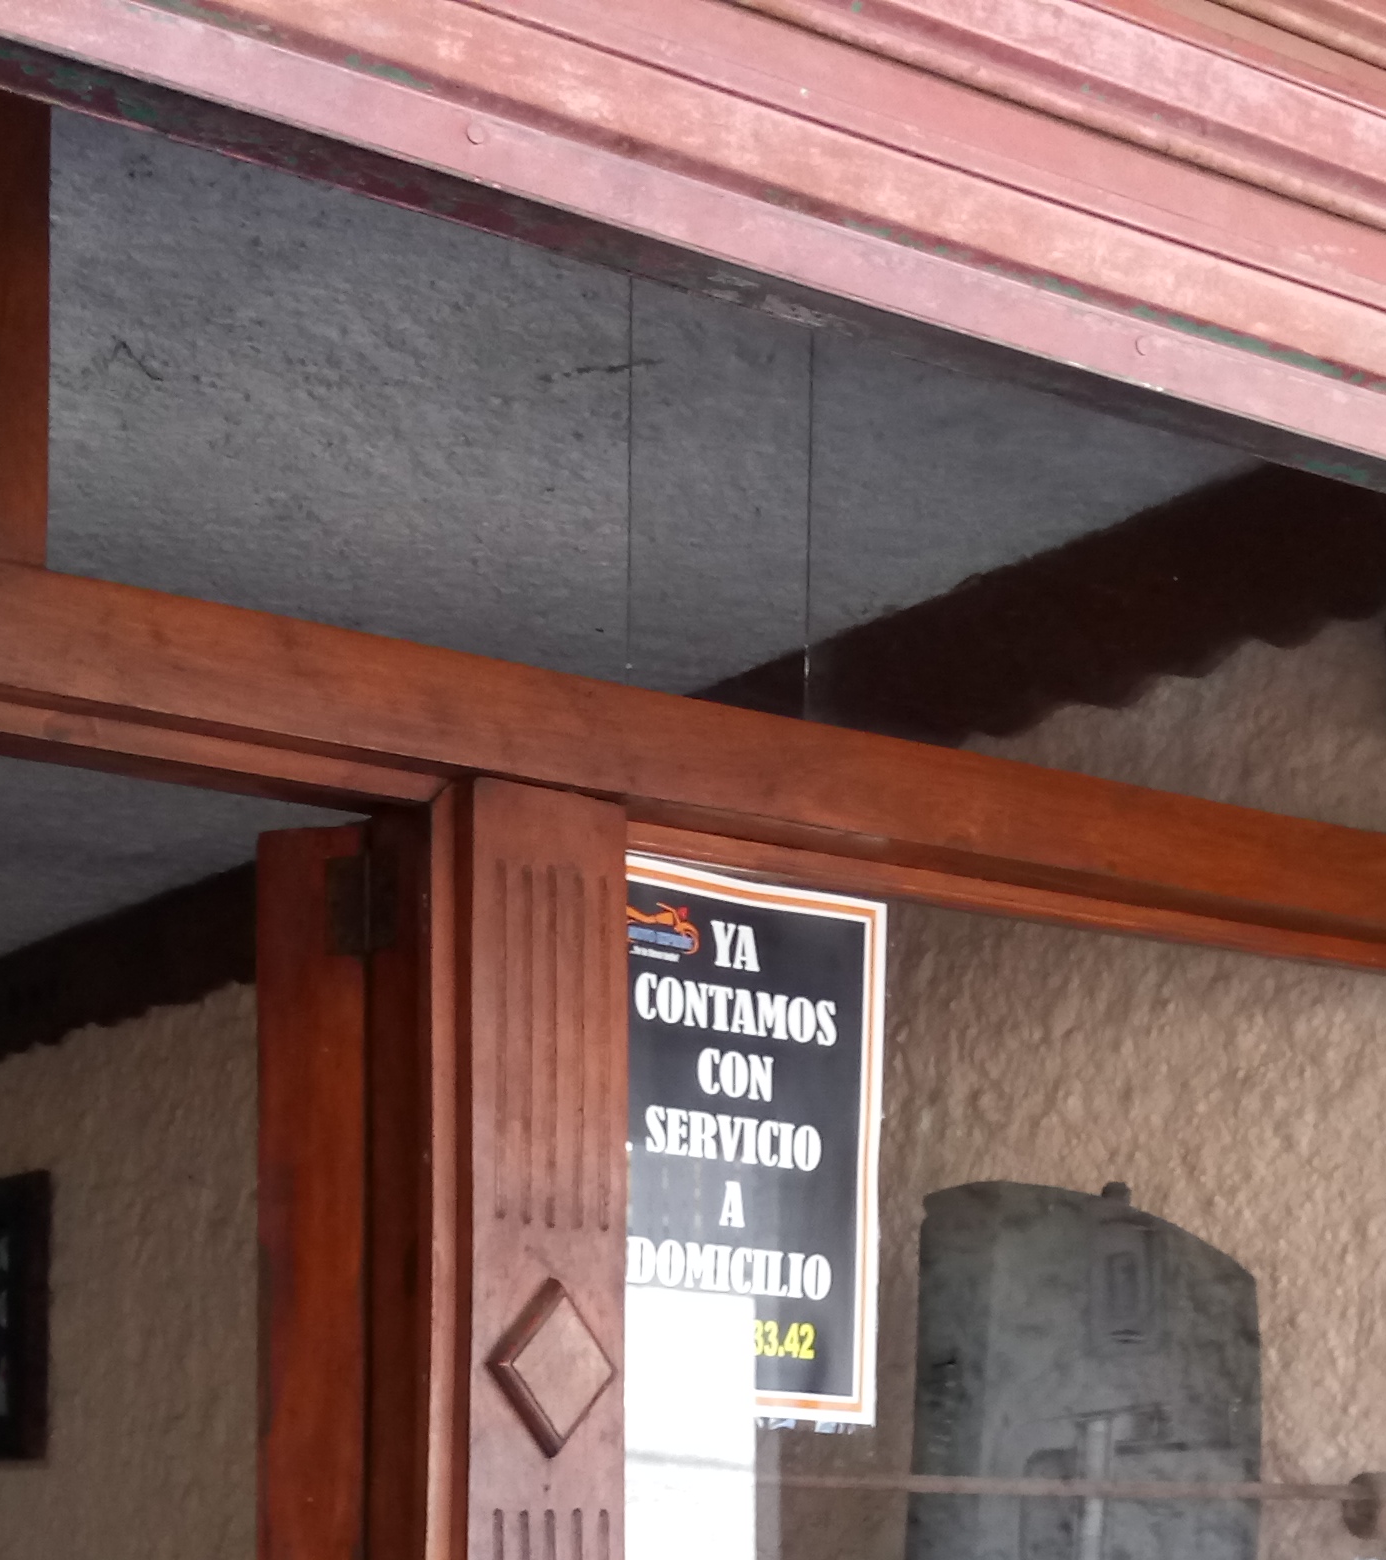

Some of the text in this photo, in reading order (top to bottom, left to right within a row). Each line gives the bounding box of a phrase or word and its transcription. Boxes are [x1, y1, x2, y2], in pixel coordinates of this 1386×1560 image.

[711, 920, 760, 972] YA
[635, 972, 837, 1046] CONTAMOS
[697, 1048, 774, 1102] CON
[645, 1105, 822, 1172] SERVICIO
[719, 1180, 746, 1229] A
[626, 1235, 832, 1301] DOMICILIO
